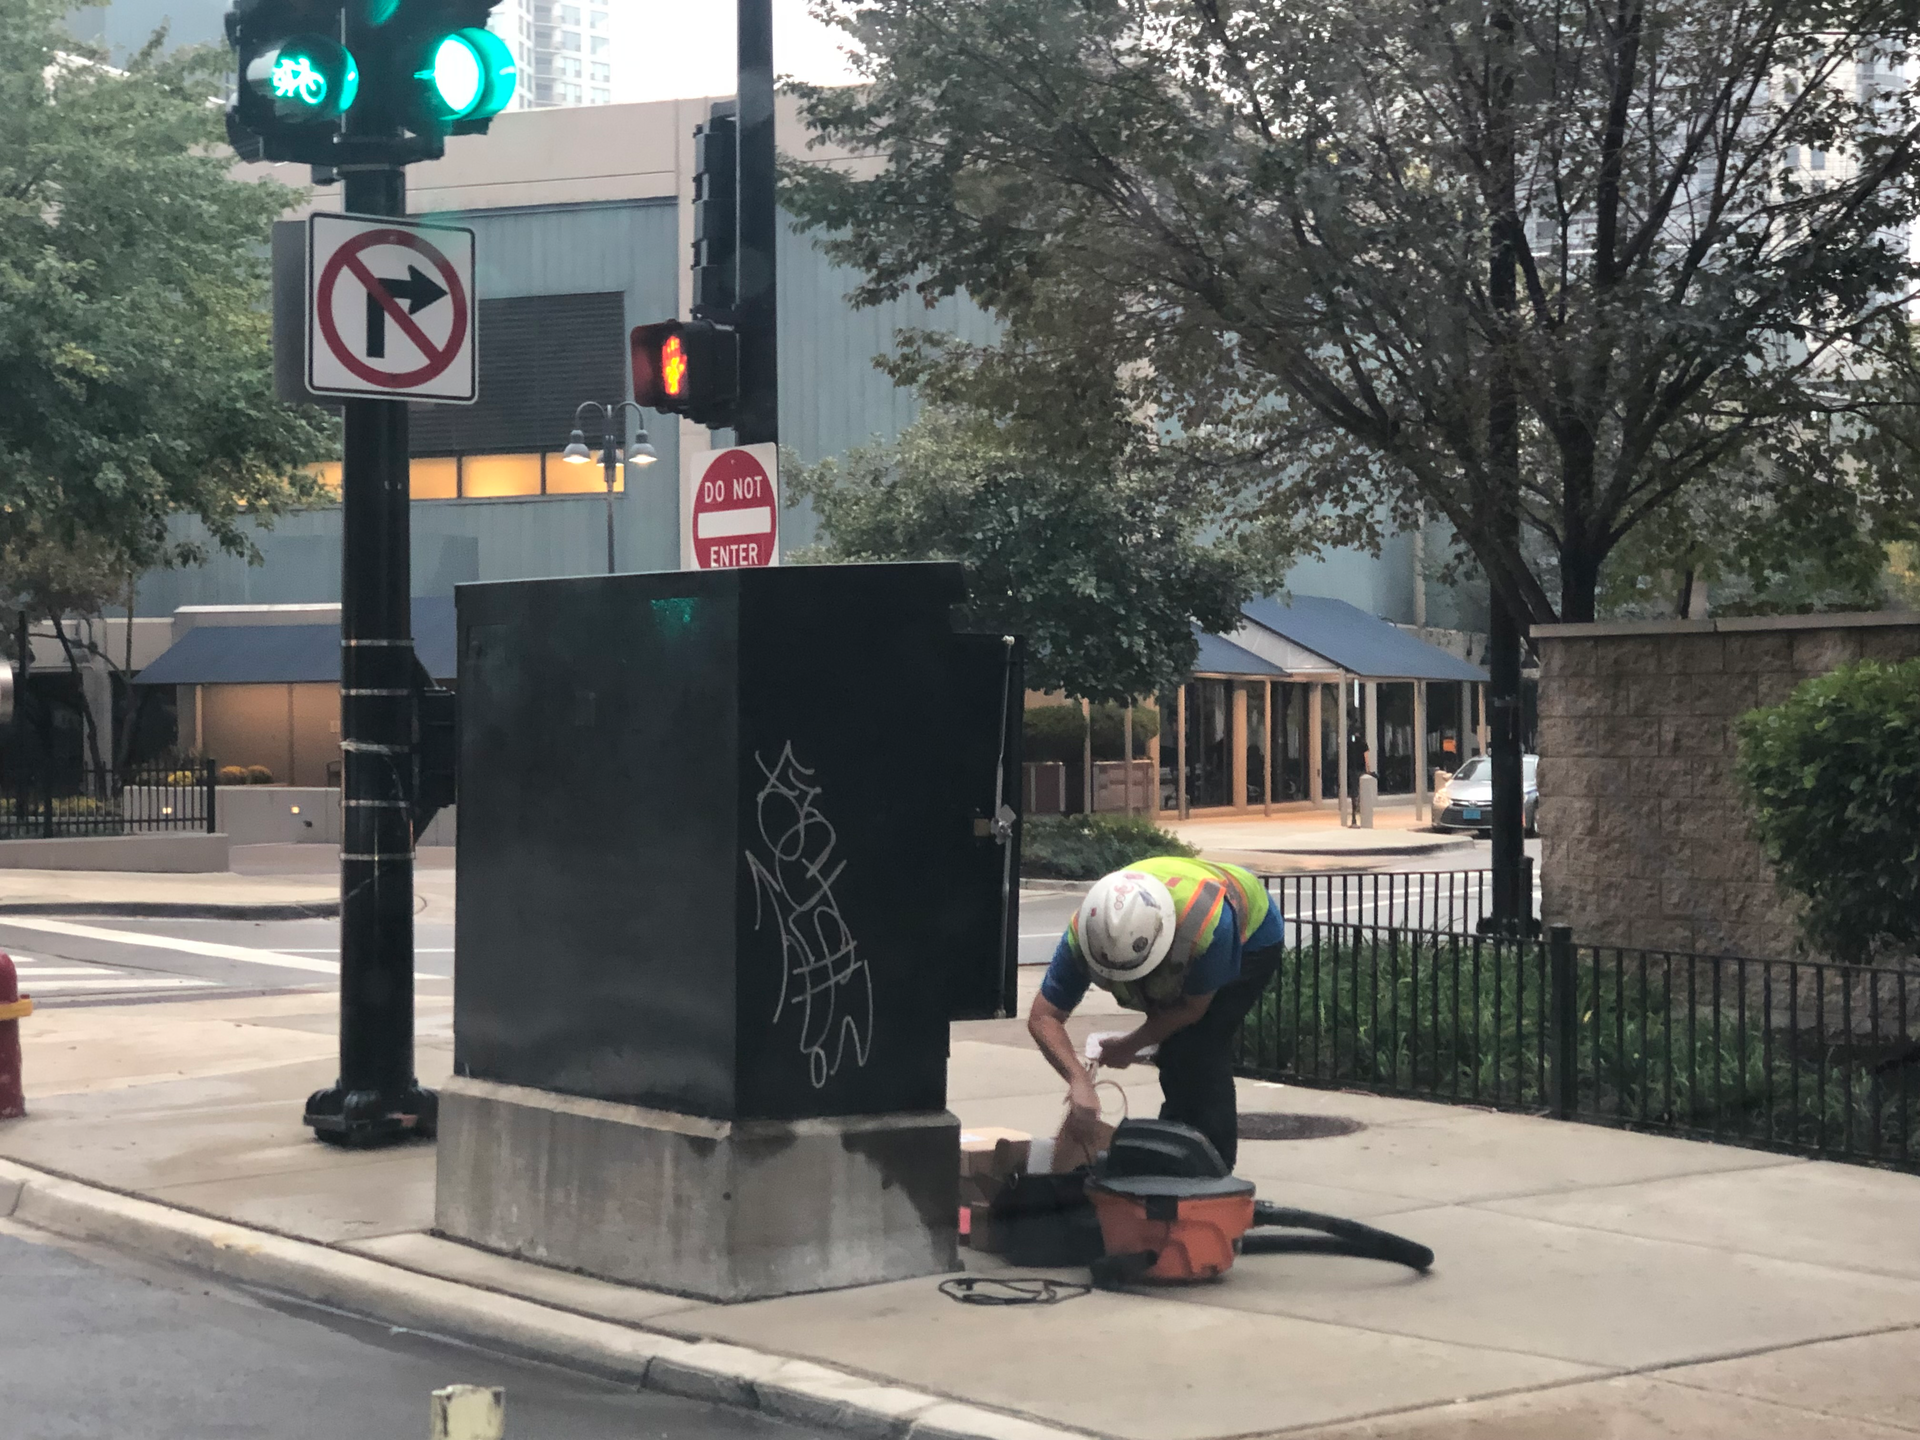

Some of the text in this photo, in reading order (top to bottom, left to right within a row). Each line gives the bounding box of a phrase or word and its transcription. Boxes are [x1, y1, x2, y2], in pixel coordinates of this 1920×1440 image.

[704, 476, 763, 503] DO NOT
[710, 543, 758, 568] ENTER
